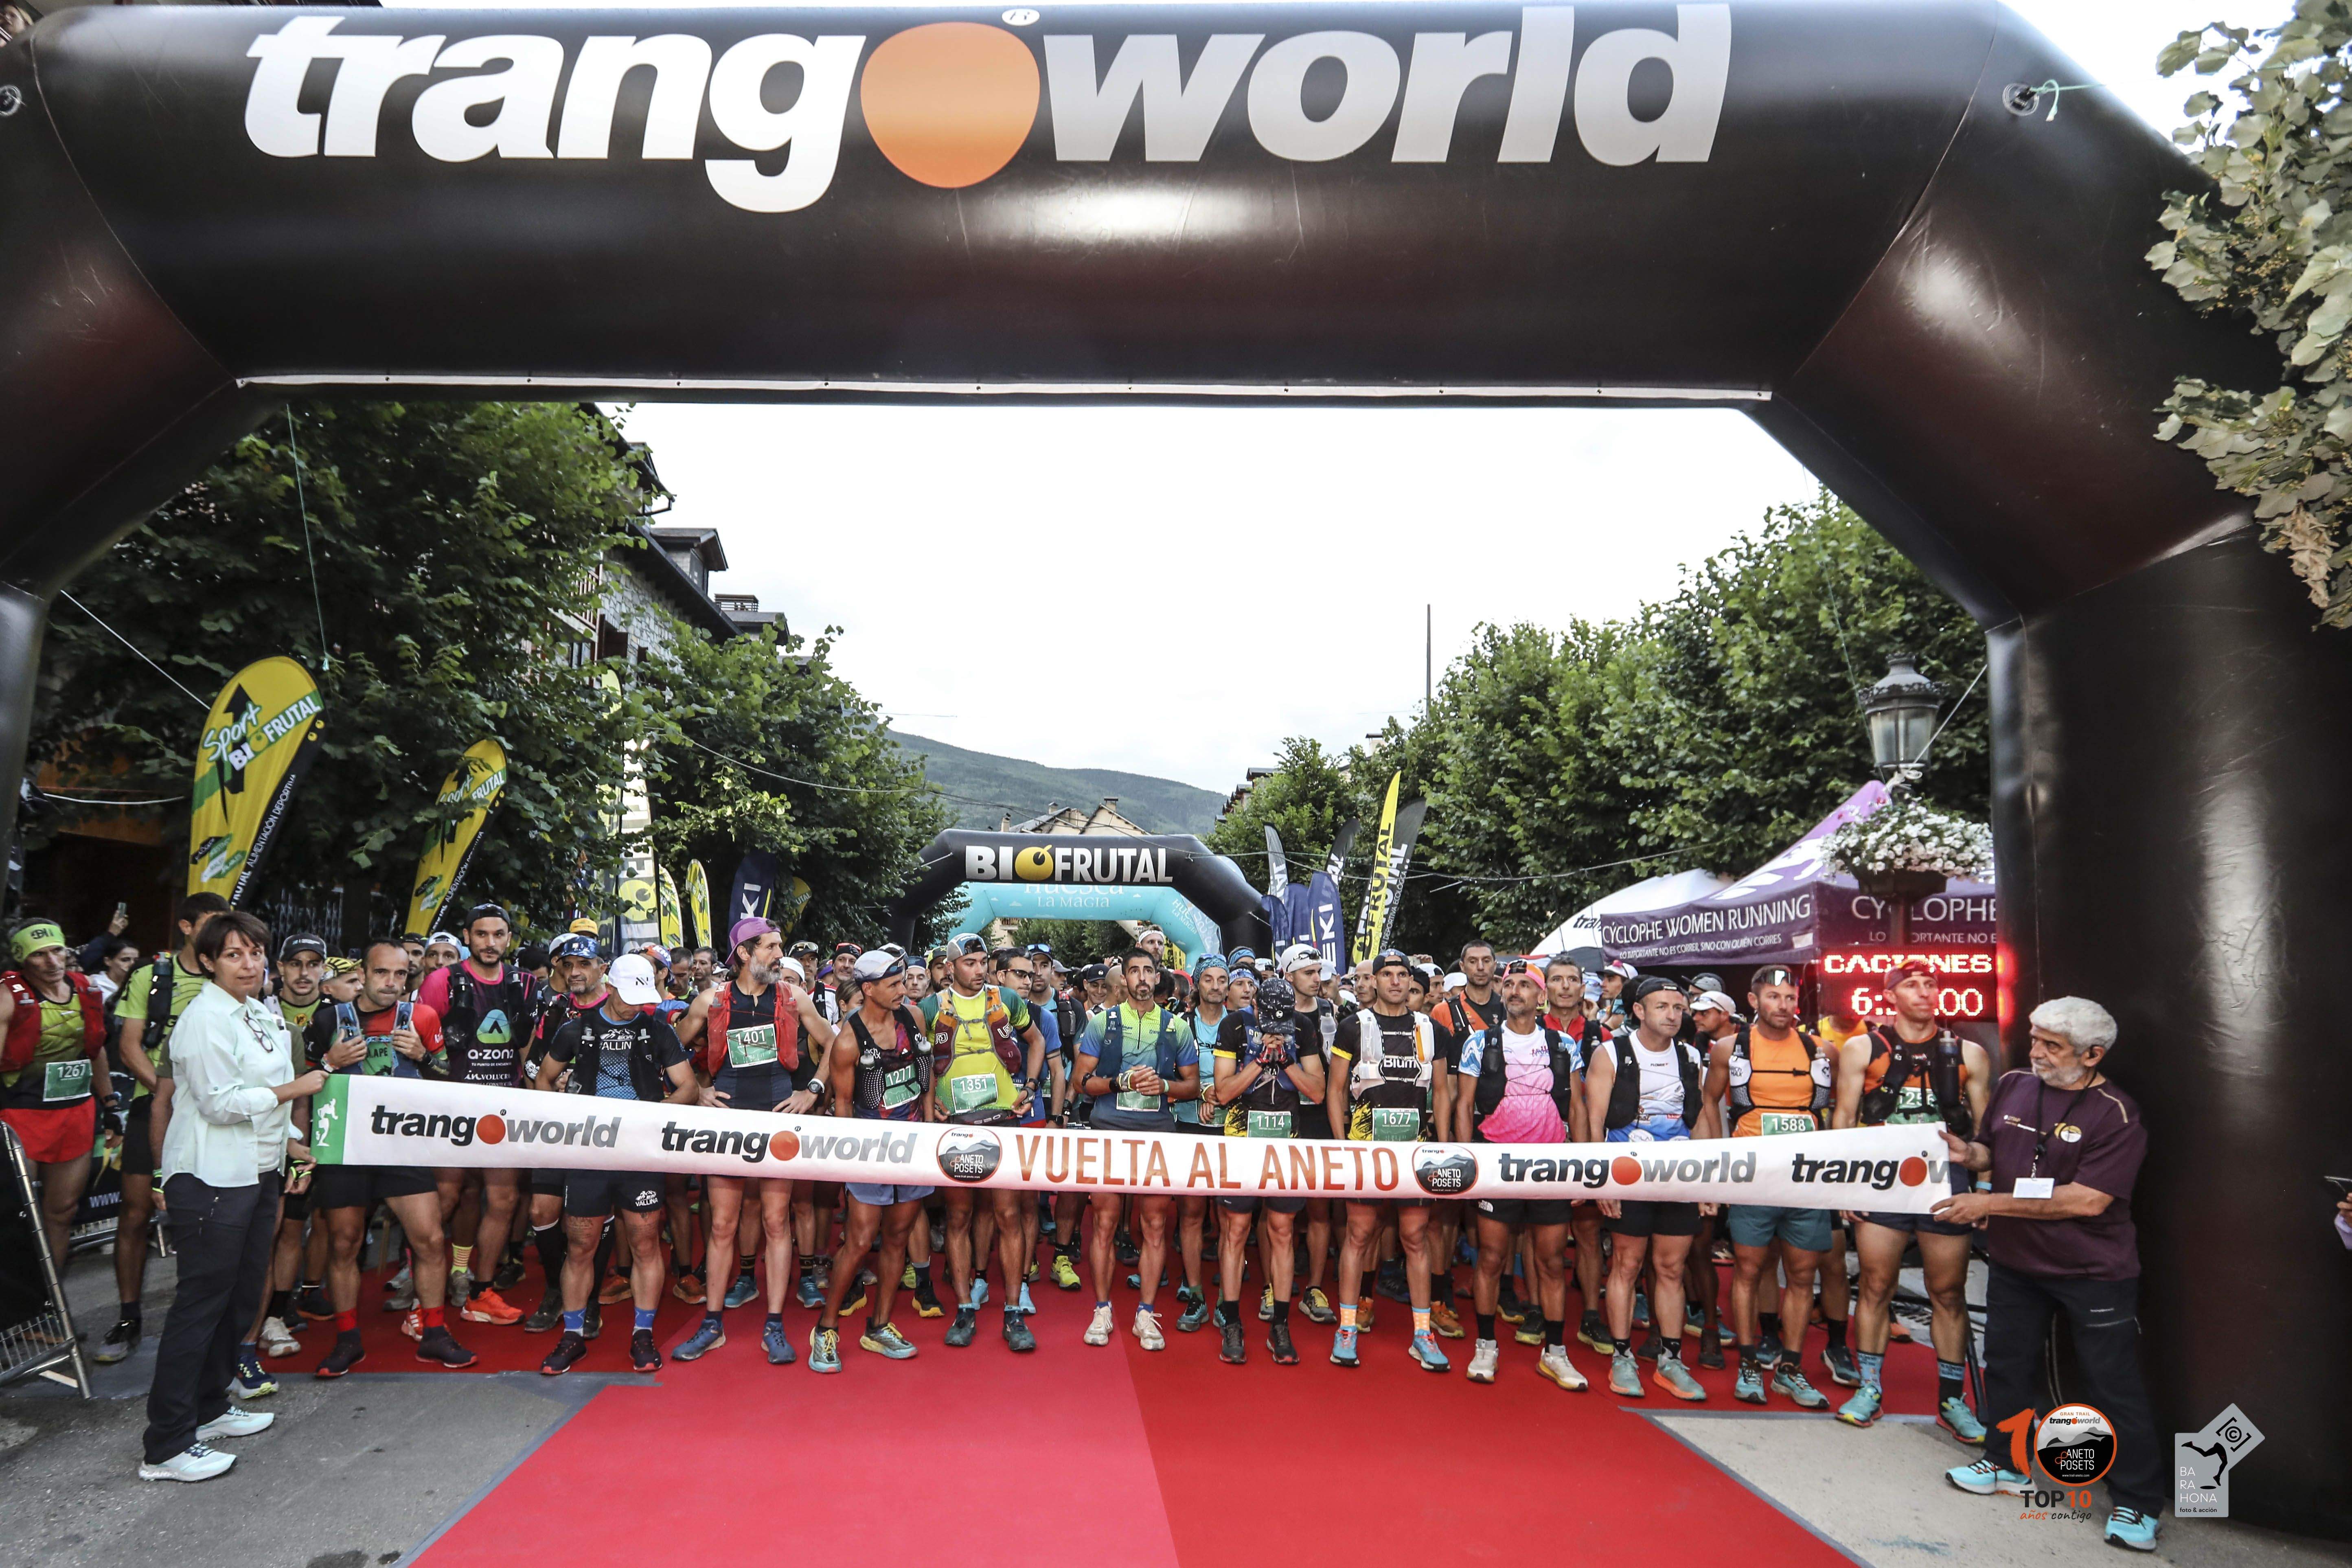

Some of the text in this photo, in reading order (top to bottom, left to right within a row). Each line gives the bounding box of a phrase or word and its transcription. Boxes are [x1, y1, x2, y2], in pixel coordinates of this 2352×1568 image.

[204, 702, 261, 762] Sport
[229, 696, 321, 771] BIOFRUTAL
[246, 814, 272, 868] ALIMENTACIÓN
[272, 774, 297, 817] DEPORTIVA
[966, 844, 1173, 883] BIOFRUTAL
[1383, 907, 1397, 941] DEPORTIVA
[1393, 871, 1407, 905] ECOLÓGICA
[1666, 910, 1724, 938] WOMEN
[1728, 894, 1811, 930] RUNNING
[1628, 948, 1658, 958] IMPORTANTE
[1659, 947, 1669, 956] NO
[1670, 945, 1677, 955] ES
[1701, 941, 1715, 950] SINO
[1716, 939, 1731, 950] CON
[1754, 933, 1782, 946] CORRES
[1869, 932, 1886, 942] LO
[1912, 932, 1965, 943] ORTANTE
[1968, 933, 1987, 943] NO
[736, 1030, 765, 1046] 1401
[57, 1064, 86, 1079] 1267
[887, 1066, 911, 1086] 1277
[960, 1079, 987, 1092] 1351
[1257, 1115, 1285, 1127] 1114
[1382, 1112, 1411, 1125] 1677
[1772, 1118, 1806, 1132] 1588
[371, 1105, 918, 1163] trangoworld trangoworld
[960, 1154, 984, 1164] ANETO
[1016, 1134, 1398, 1191] VUELTA AL ANETO
[954, 1163, 983, 1173] POSETS
[1437, 1168, 1461, 1178] ANETO
[1498, 1151, 1756, 1189] trangoworld
[1432, 1178, 1461, 1187] POSETS
[635, 1197, 658, 1207] VALLINA
